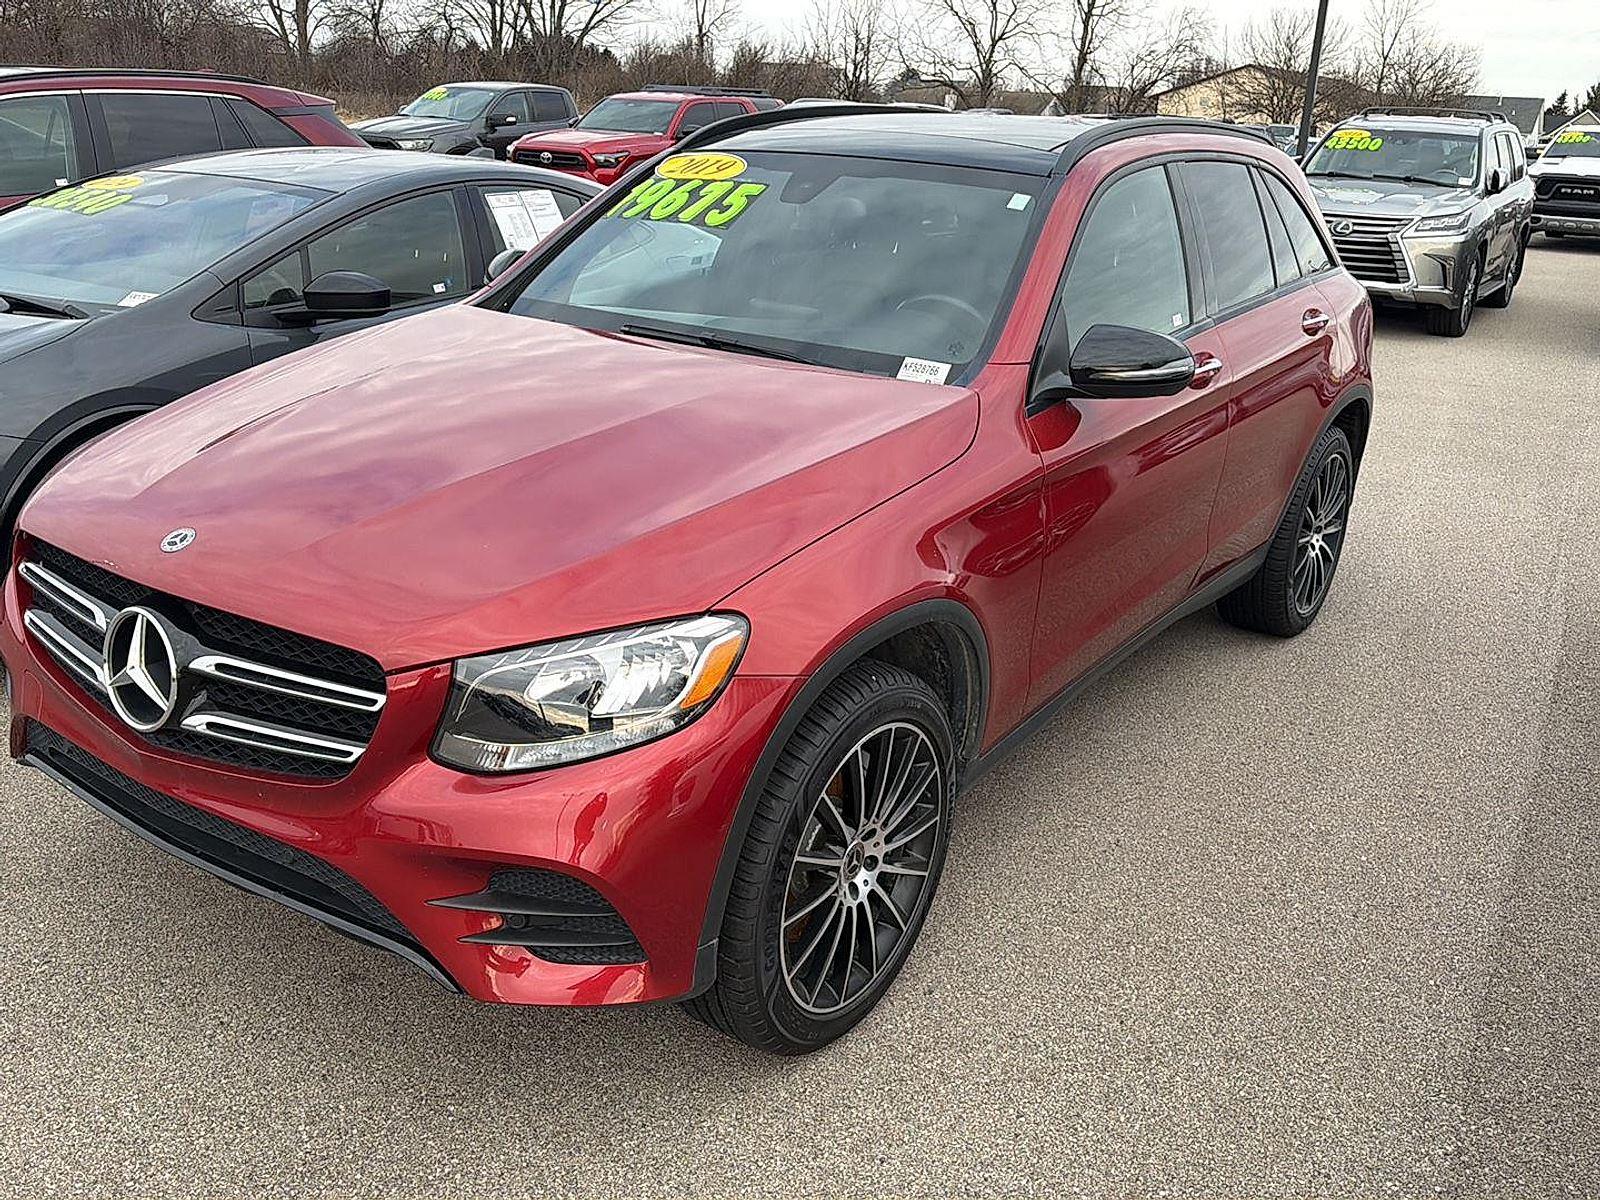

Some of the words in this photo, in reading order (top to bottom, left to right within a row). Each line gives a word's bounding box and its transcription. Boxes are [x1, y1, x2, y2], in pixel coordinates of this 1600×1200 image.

[665, 157, 738, 176] 2019
[1560, 187, 1595, 195] RAM
[606, 178, 769, 227] 19675
